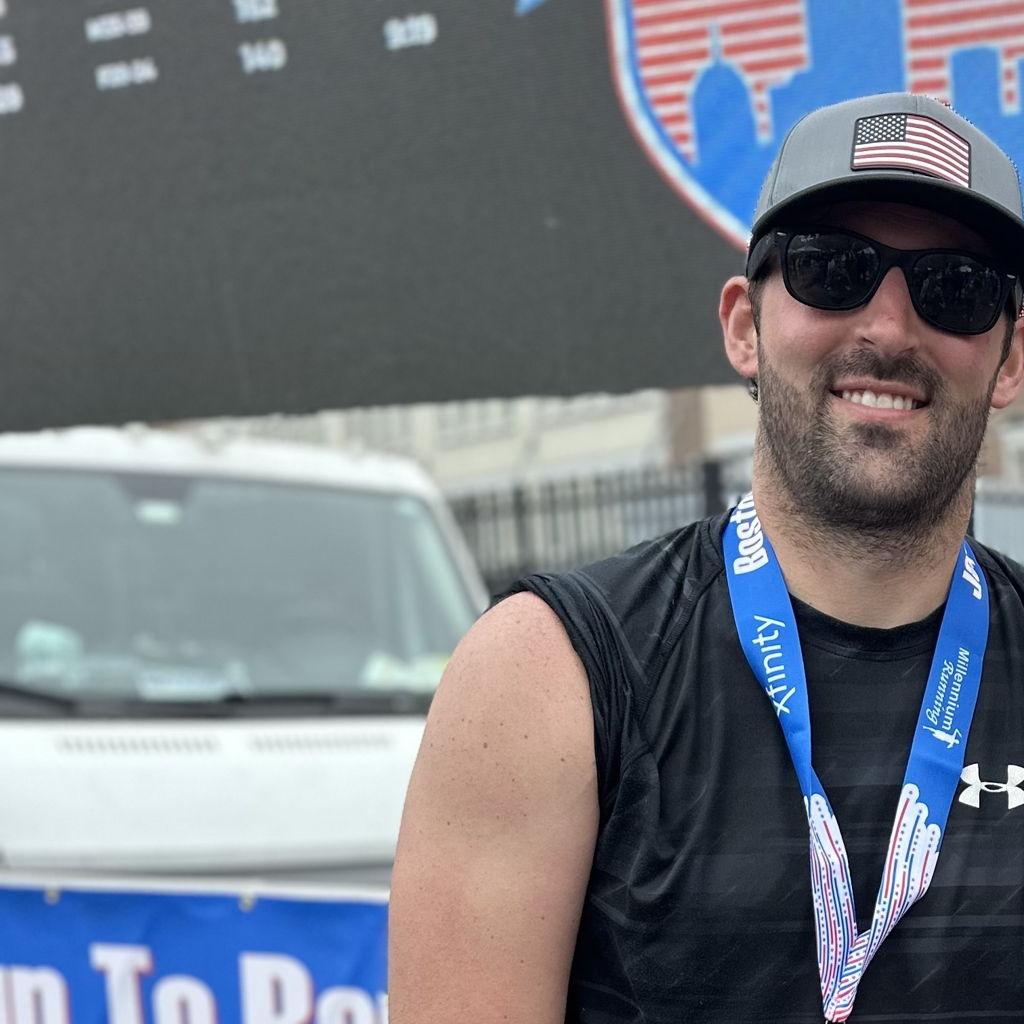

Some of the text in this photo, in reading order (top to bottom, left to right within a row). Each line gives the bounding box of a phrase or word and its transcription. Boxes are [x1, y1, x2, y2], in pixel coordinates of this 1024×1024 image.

[752, 615, 797, 717] xfinity
[925, 659, 954, 726] Running
[941, 647, 970, 731] Millennium
